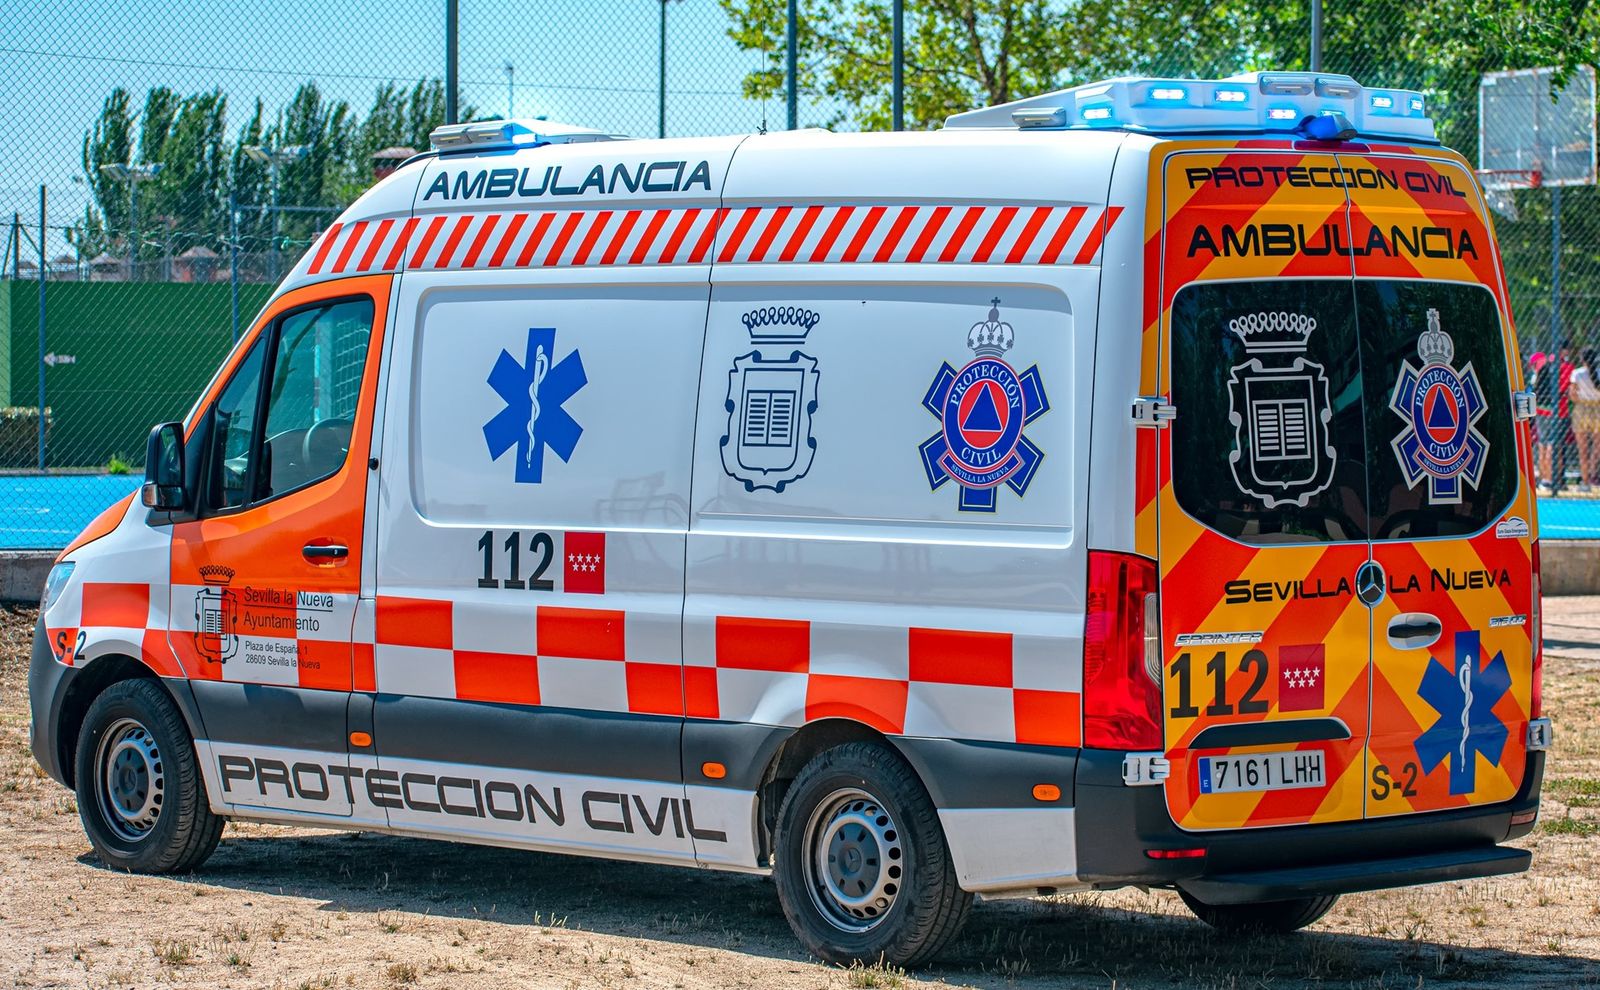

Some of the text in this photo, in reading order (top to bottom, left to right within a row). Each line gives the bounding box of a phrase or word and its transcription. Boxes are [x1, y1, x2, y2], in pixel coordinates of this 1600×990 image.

[423, 160, 711, 200] AMBULANCIA
[1185, 166, 1466, 197] PROTECCION CIVIL
[1187, 224, 1478, 260] AMBULANCIA
[950, 364, 1020, 409] PROTECCIÓN
[961, 447, 1001, 465] CIVIL
[1429, 442, 1458, 457] CIVIL
[951, 464, 976, 482] SEVILLA
[987, 466, 1009, 482] NUEVA
[478, 531, 554, 591] 112
[244, 586, 333, 607] Sevilla la Nueva
[243, 611, 320, 631] Ayuntamiento
[56, 631, 87, 661] S-2
[245, 641, 264, 652] Plaza
[265, 643, 273, 652] de
[1176, 632, 1263, 646] SPRINTER
[246, 654, 321, 669] 28609 Sevilla la Nueva
[1170, 649, 1269, 719] 112
[1203, 779, 1208, 788] E
[1216, 755, 1321, 789] 7161 LHH
[1371, 762, 1418, 801] S-2
[218, 755, 727, 843] PROTECCION CIVIL
